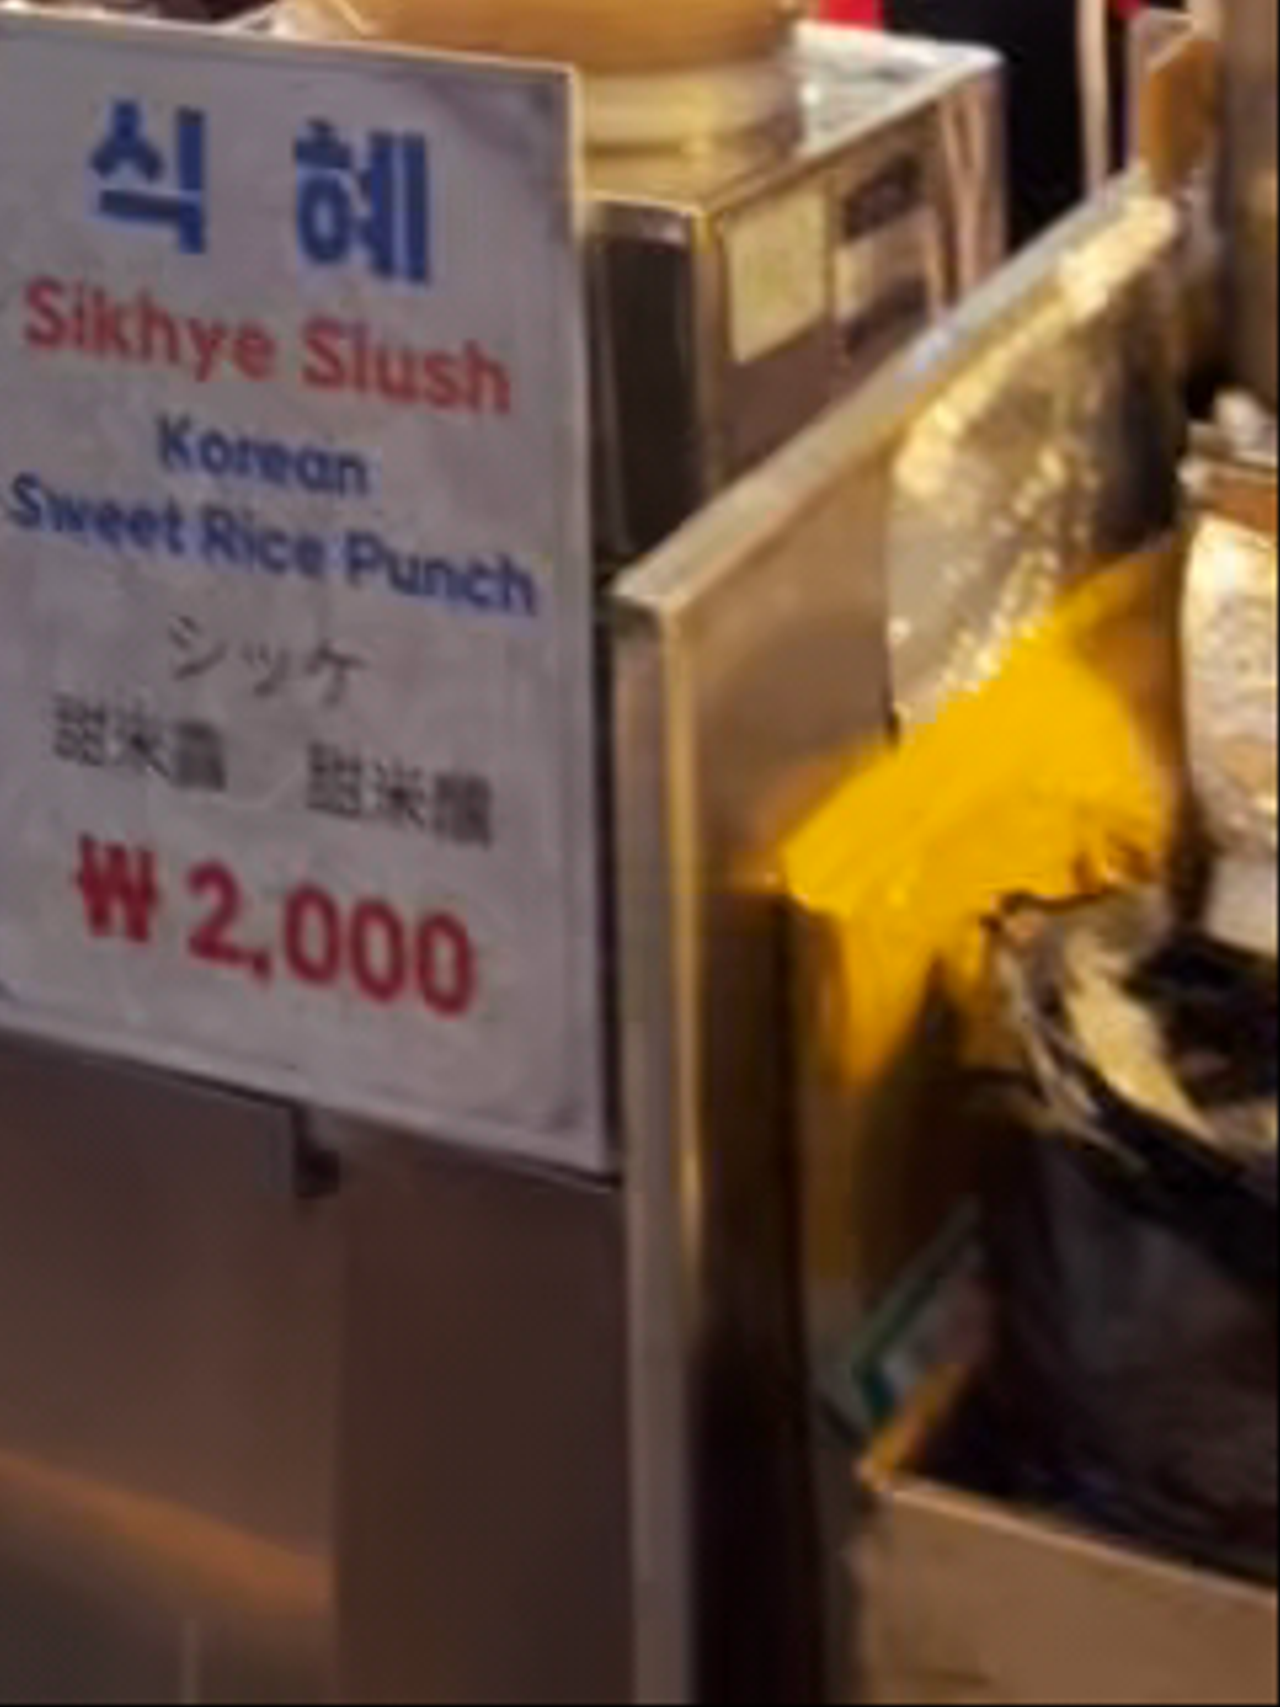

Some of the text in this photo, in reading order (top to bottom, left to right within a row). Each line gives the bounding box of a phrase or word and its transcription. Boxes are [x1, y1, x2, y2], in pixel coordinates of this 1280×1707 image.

[23, 279, 512, 416] Sikhye Slush
[156, 415, 367, 497] Korean
[7, 477, 536, 619] Sweet Rice Punch
[168, 615, 366, 706] シッケ
